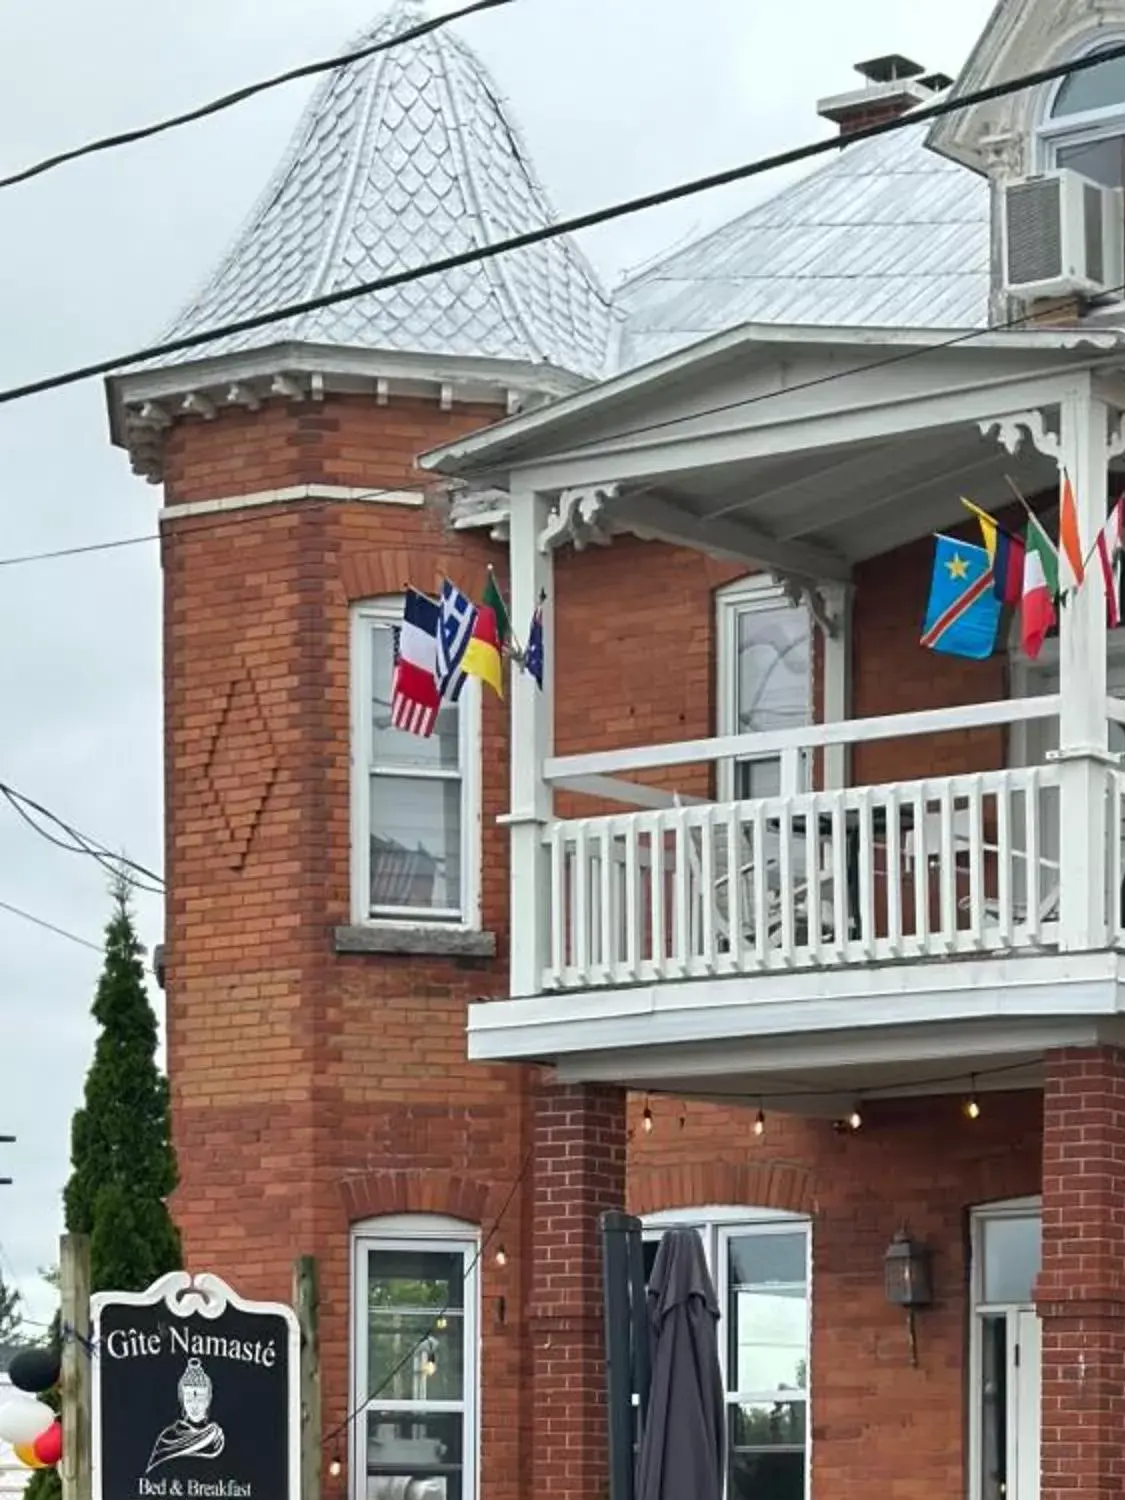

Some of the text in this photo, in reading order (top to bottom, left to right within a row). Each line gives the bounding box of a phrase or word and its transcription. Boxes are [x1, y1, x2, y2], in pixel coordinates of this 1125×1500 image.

[107, 1326, 277, 1367] Gîte Namasté
[139, 1479, 251, 1497] Bed & Breakfast
